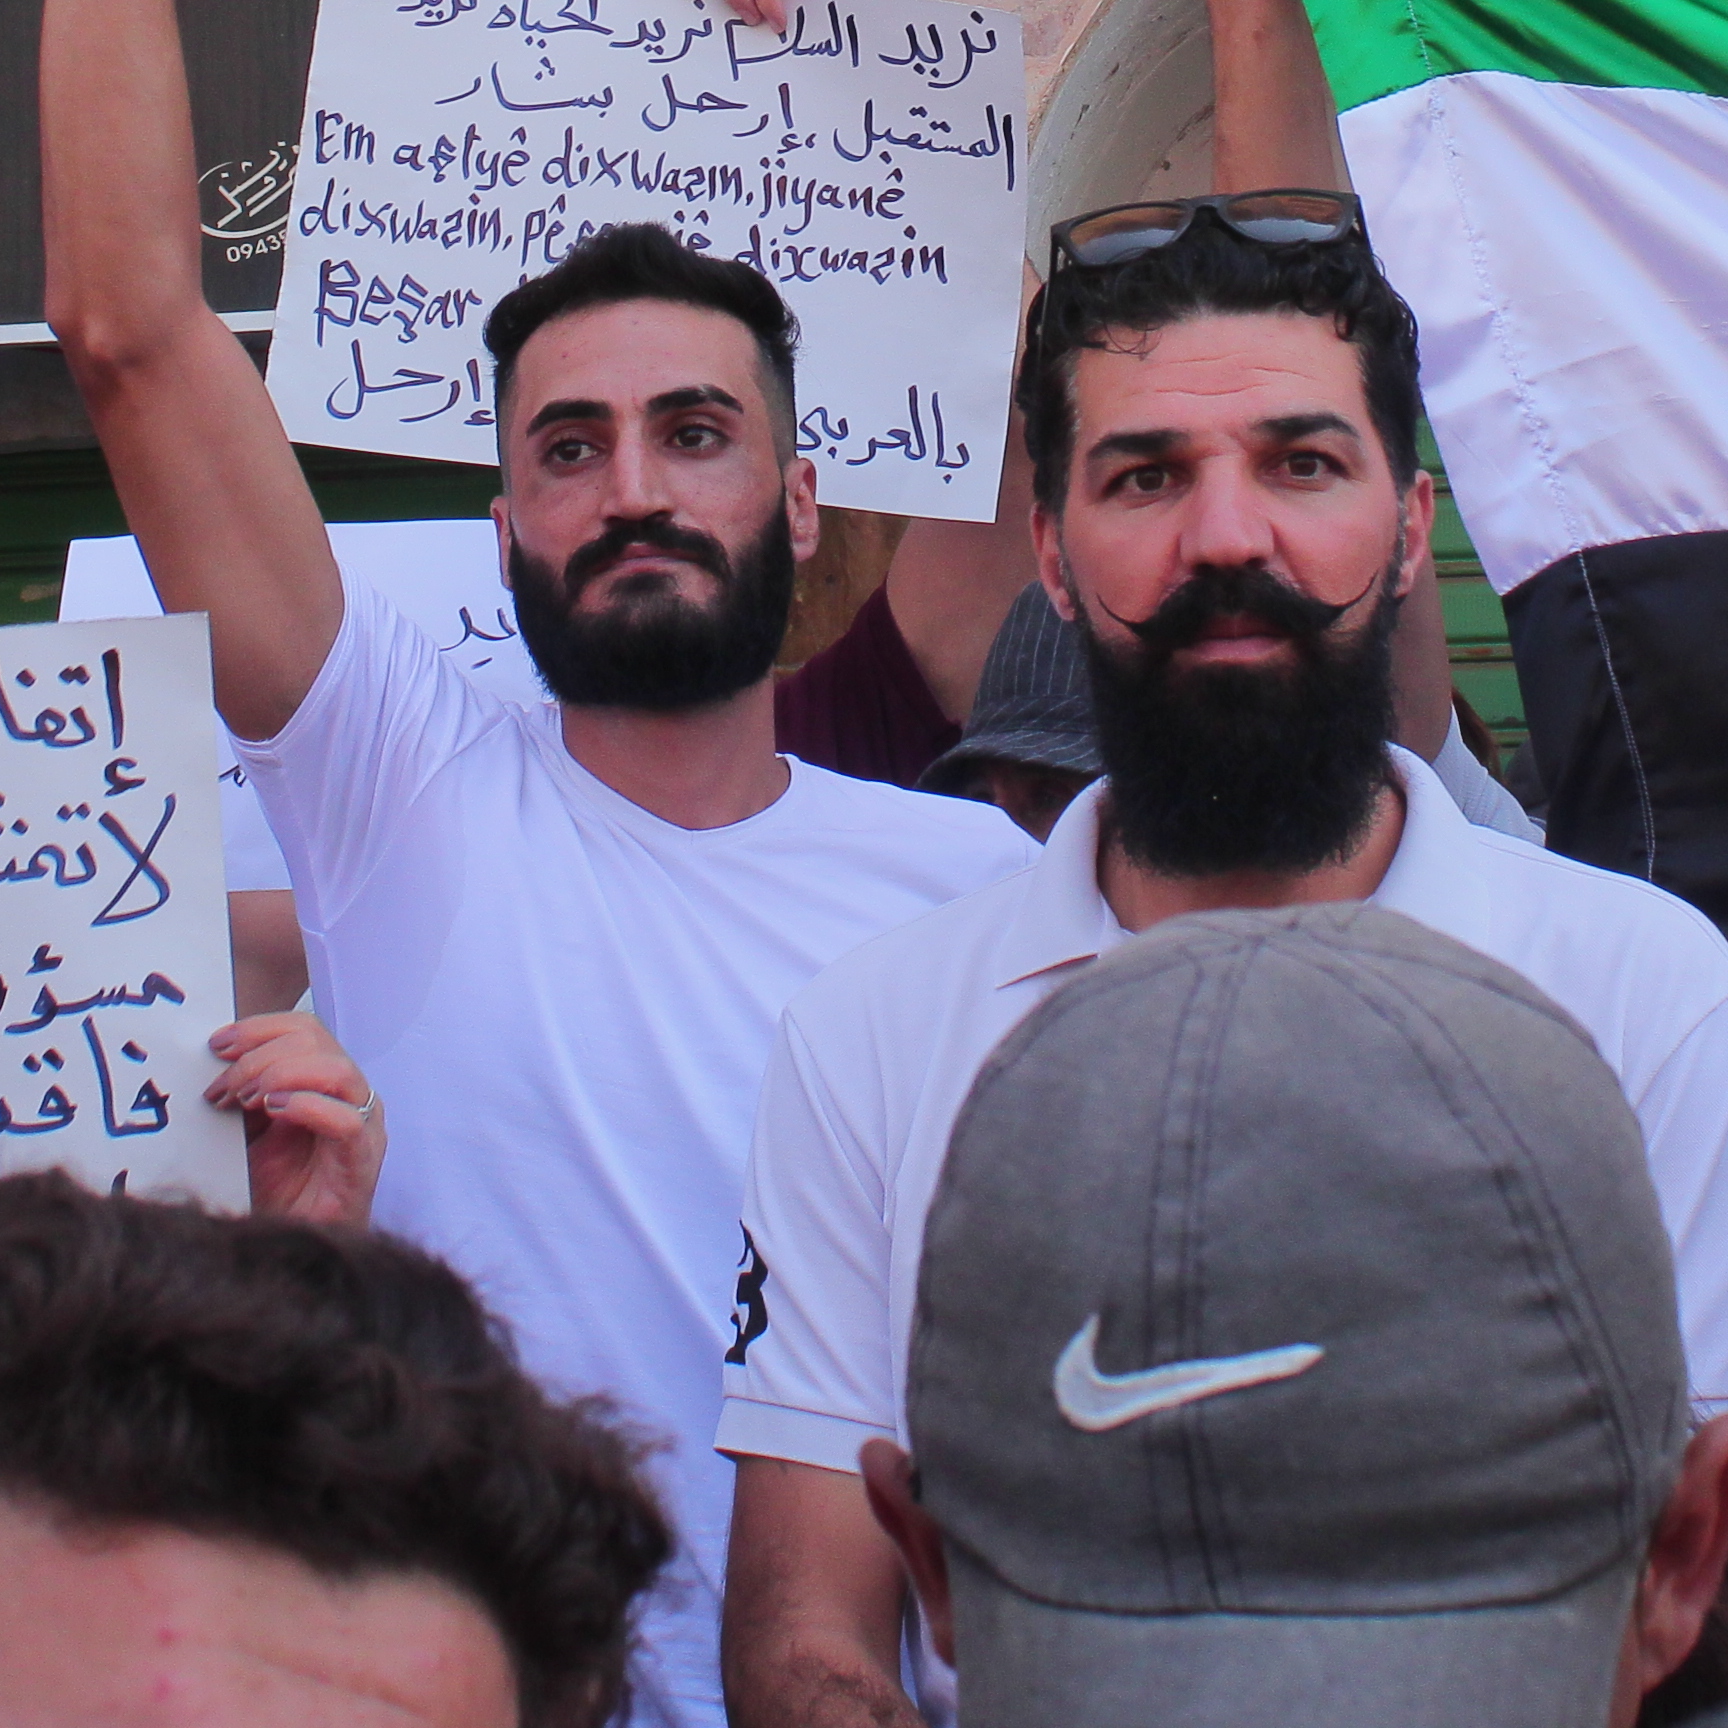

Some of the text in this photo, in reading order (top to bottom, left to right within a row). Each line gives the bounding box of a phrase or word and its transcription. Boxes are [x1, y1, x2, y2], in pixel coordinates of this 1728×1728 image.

[878, 10, 998, 89] نريد
[433, 56, 614, 118] بشار
[315, 109, 376, 165] Em
